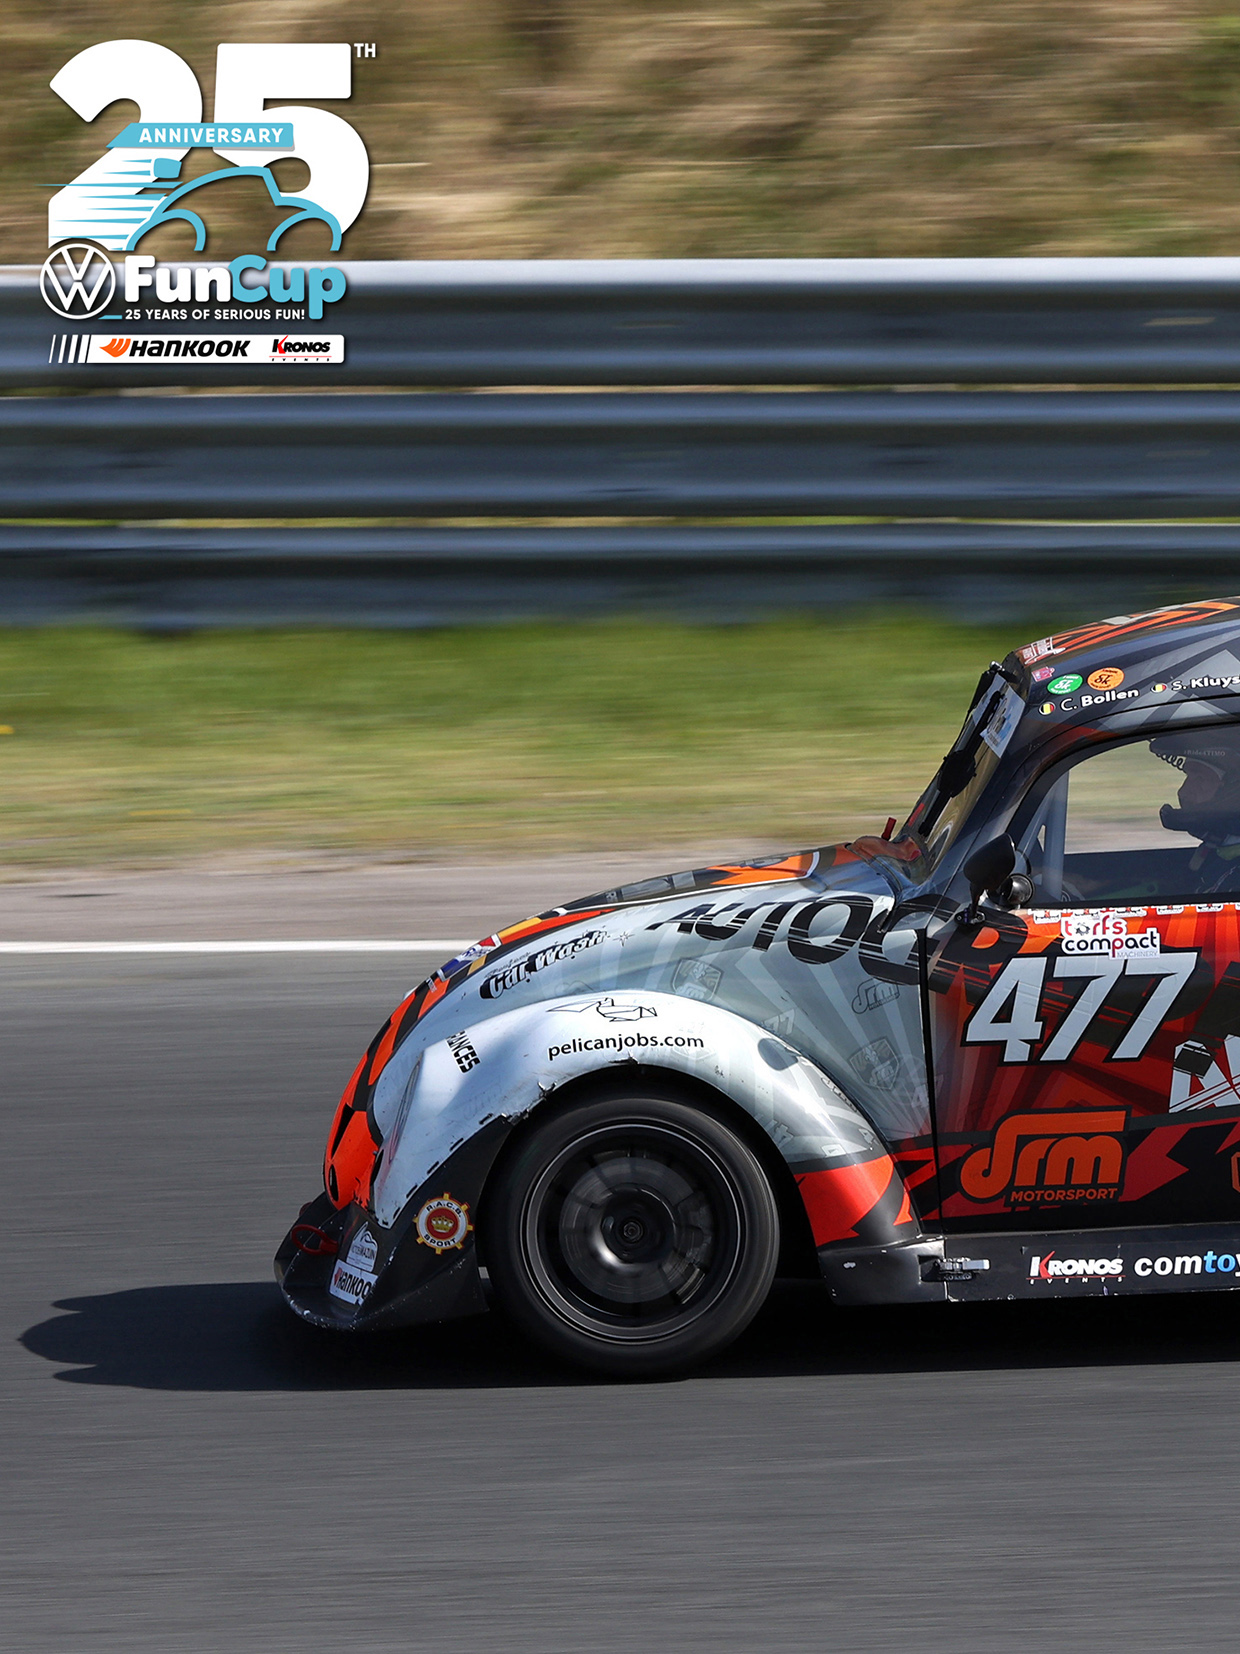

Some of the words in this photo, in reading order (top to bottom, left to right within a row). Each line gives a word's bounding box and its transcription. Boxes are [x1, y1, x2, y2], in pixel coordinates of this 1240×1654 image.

[1171, 680, 1187, 691] S.
[1060, 698, 1078, 712] C.
[1080, 689, 1140, 707] Bollen
[1064, 931, 1158, 958] compact
[964, 950, 1200, 1064] 477
[547, 1032, 705, 1062] pelicanjobs.com
[1010, 1187, 1118, 1203] MOTORSPORT
[423, 1233, 457, 1247] SPORT
[1029, 1250, 1124, 1279] KRONOS
